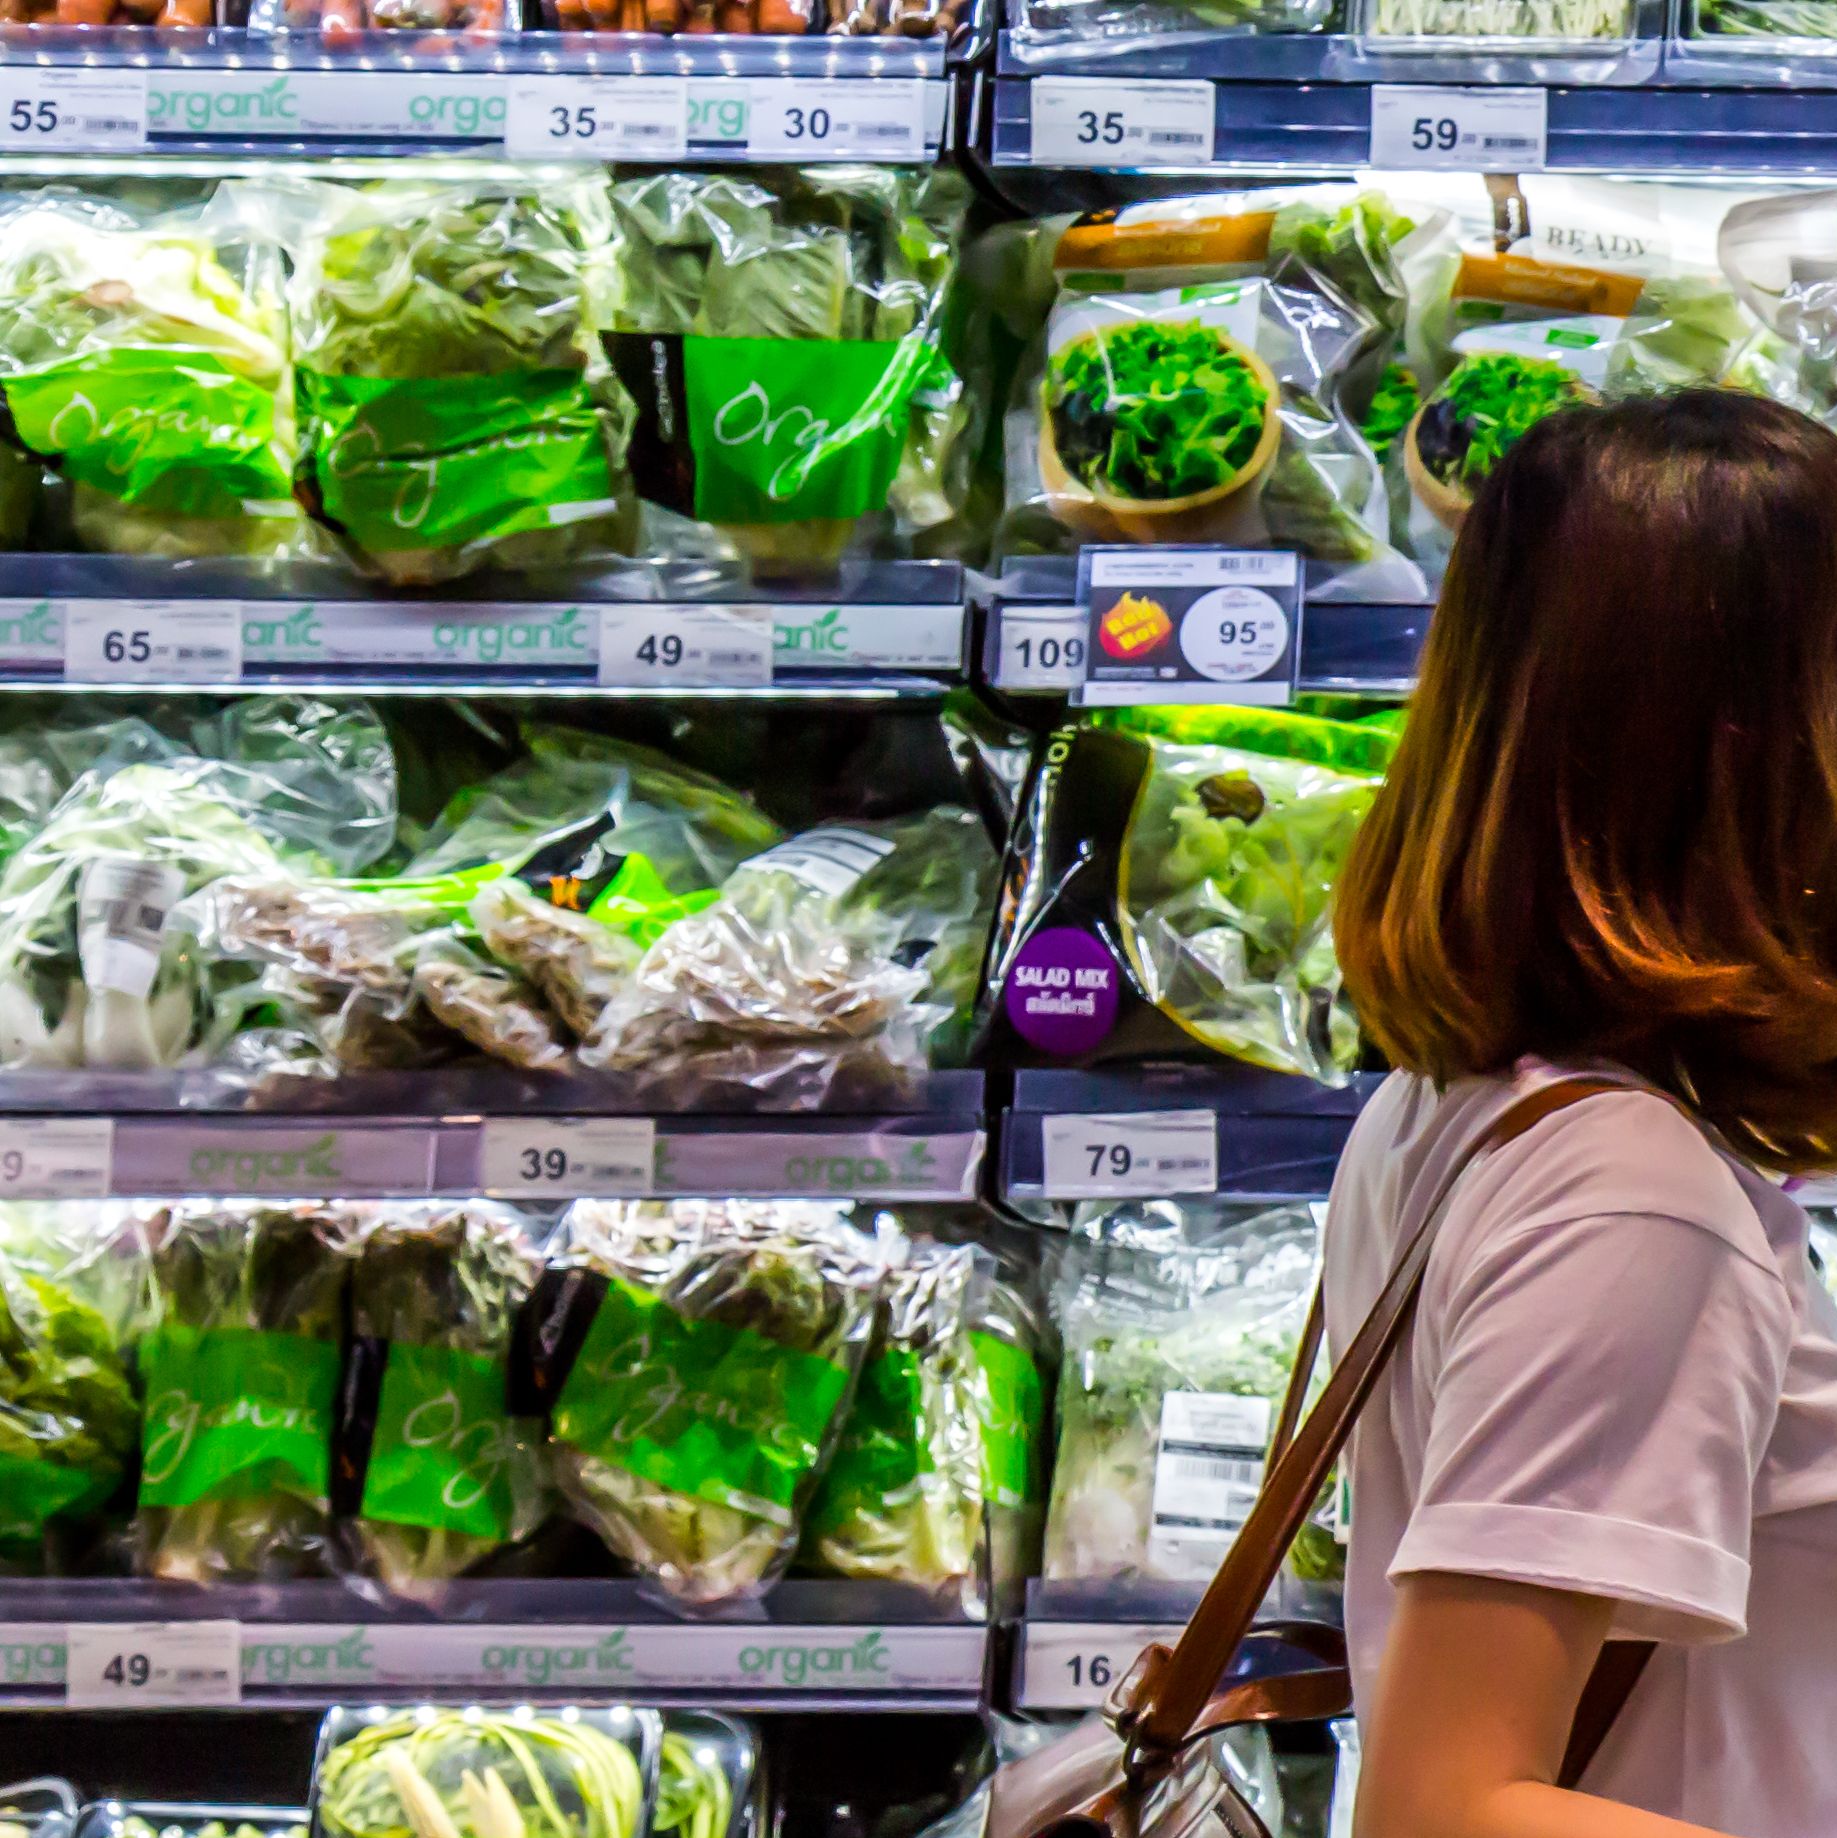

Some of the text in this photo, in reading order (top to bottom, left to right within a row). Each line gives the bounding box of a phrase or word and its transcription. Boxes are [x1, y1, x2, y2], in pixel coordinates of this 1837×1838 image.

[1015, 965, 1071, 988] SALAD
[481, 1636, 634, 1684] organic
[737, 1639, 890, 1684] organic
